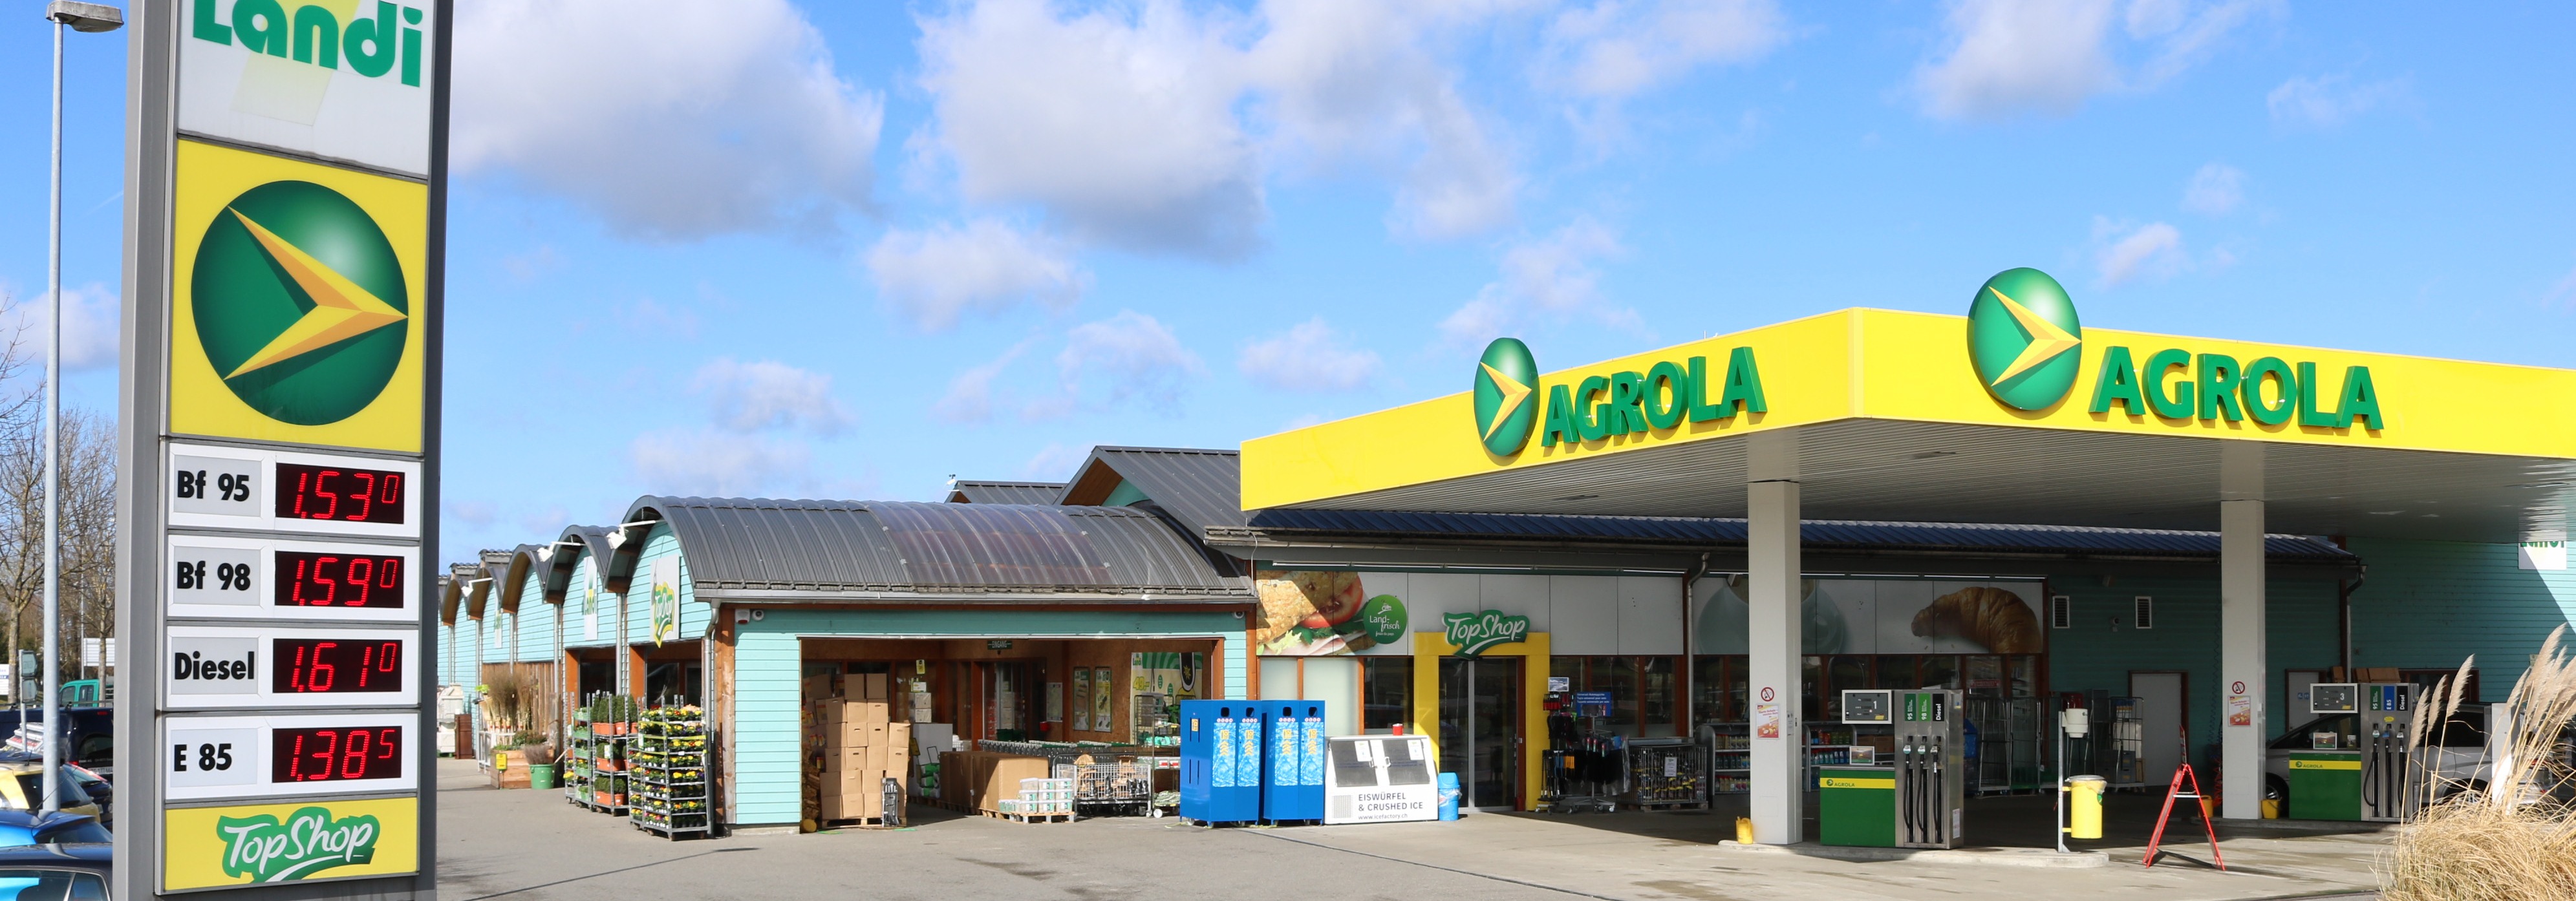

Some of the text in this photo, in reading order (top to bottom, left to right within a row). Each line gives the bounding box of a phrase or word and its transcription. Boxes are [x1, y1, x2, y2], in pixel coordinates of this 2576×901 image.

[193, 0, 423, 87] Landi
[1541, 346, 1767, 447] AGROLA
[2088, 346, 2384, 431] AGROLA
[177, 471, 250, 502] Bf 95
[177, 561, 251, 591] Bf 98
[1380, 620, 1401, 632] frisch
[175, 651, 255, 681] Diesel
[1873, 700, 1877, 710] 1
[174, 743, 232, 772] E 85
[1358, 792, 1406, 801] EISWÜRFEL
